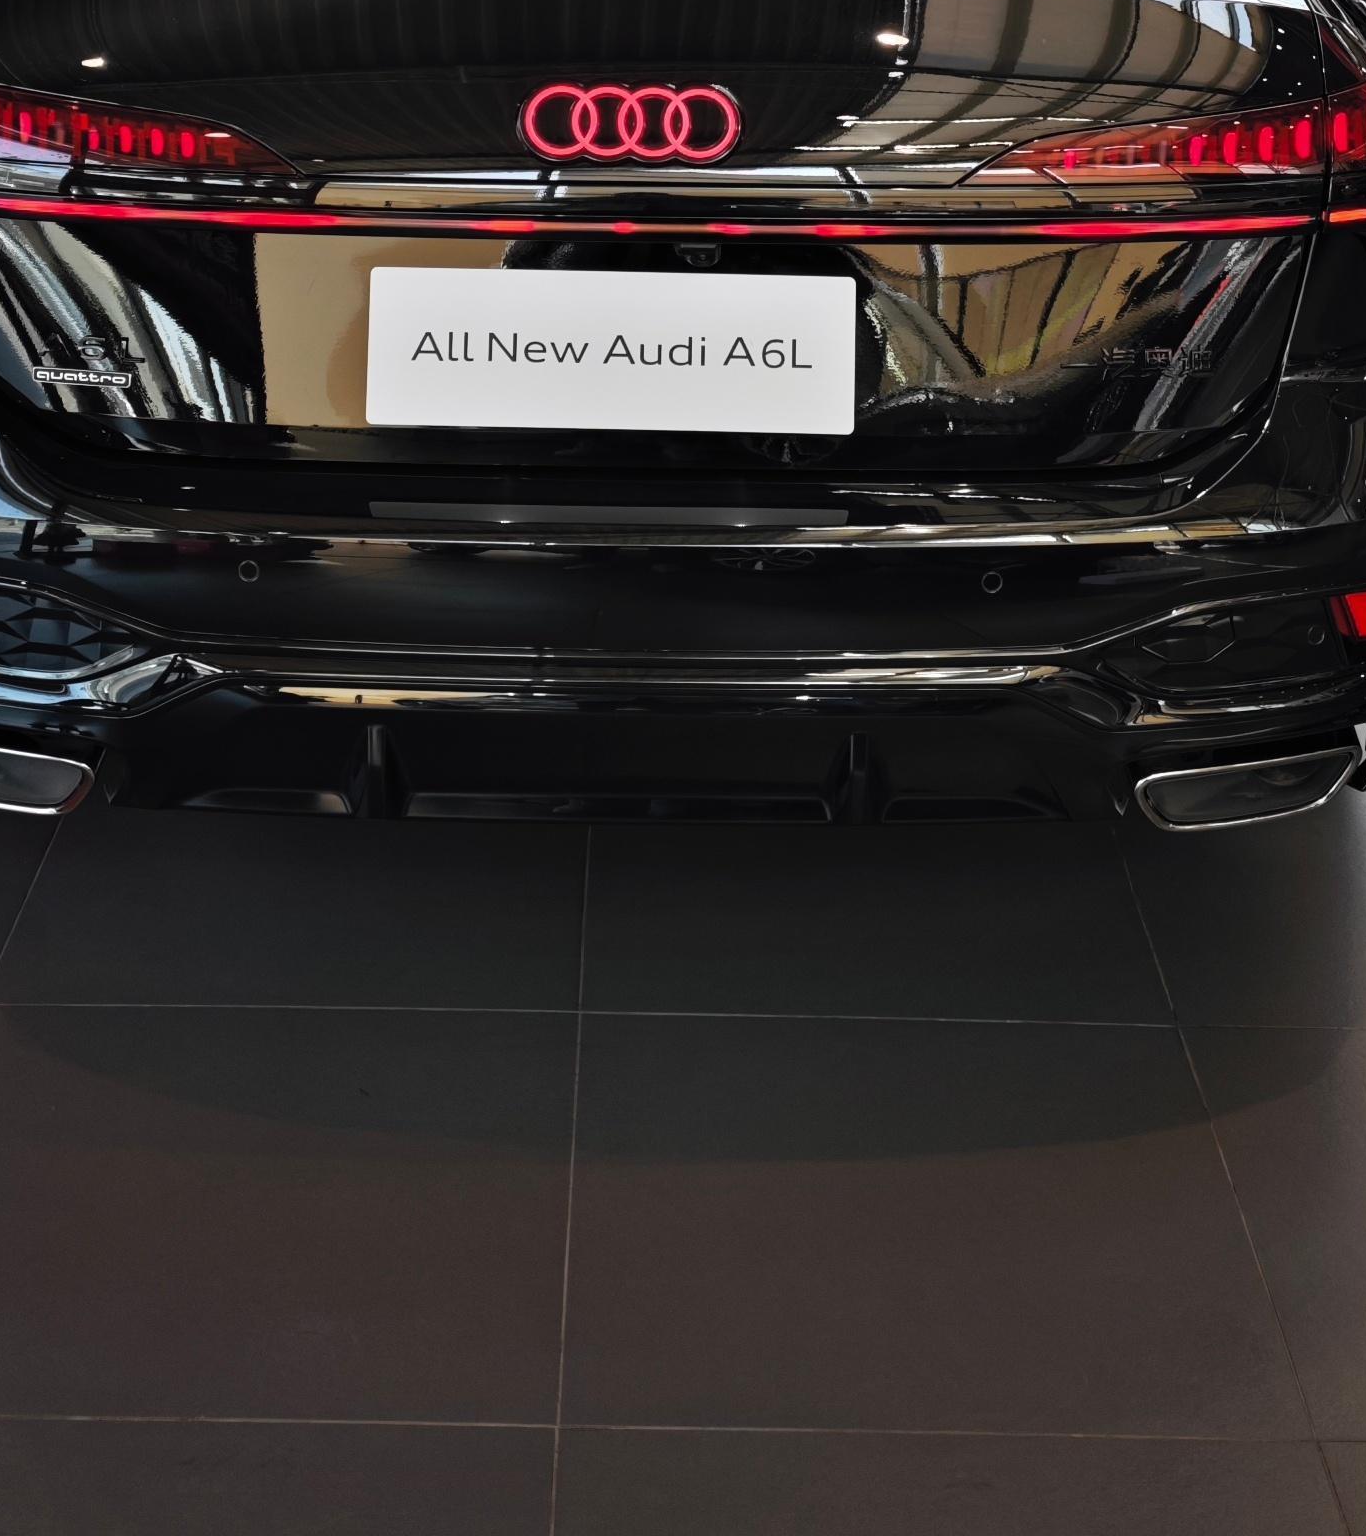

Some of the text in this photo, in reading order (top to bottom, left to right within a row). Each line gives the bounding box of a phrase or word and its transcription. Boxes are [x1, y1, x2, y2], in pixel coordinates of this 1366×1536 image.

[410, 331, 814, 369] All New Audi A6L
[35, 369, 128, 385] quattro
